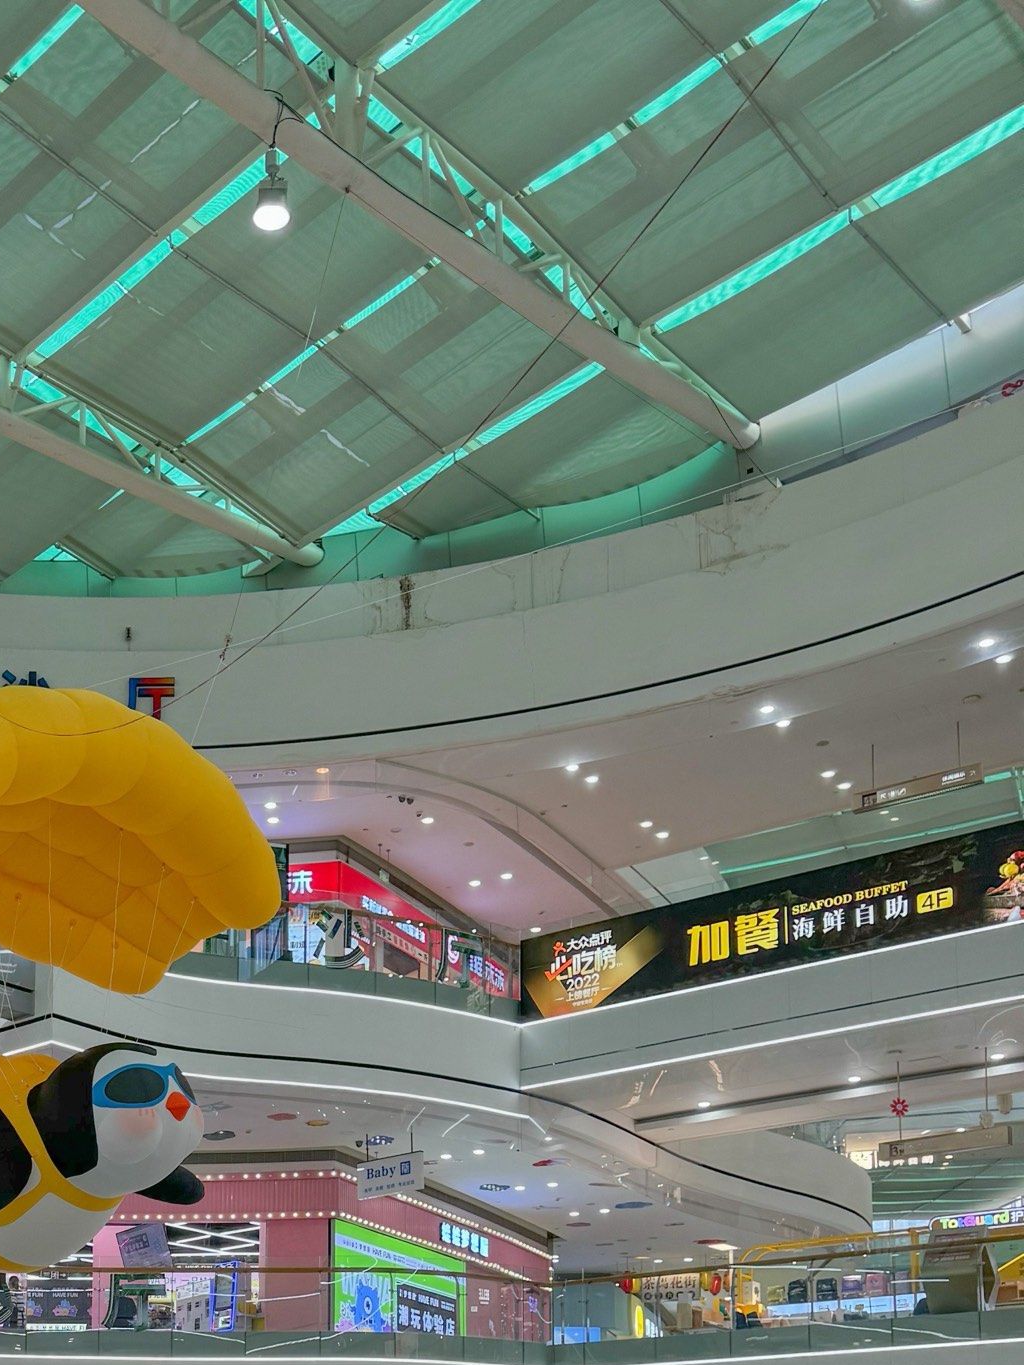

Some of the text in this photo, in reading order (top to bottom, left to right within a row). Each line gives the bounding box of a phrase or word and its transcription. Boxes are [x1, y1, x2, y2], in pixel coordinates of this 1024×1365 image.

[791, 880, 910, 917] SEAFOOD BUFFET
[920, 889, 949, 911] 4F
[792, 895, 909, 942] 海鲜自助
[566, 929, 613, 953] 大众点评
[686, 908, 780, 967] 加餐
[544, 944, 618, 983] 必吃榜
[566, 973, 600, 992] 2022
[366, 1165, 397, 1180] Baby
[398, 1304, 456, 1337] 潮玩体验店
